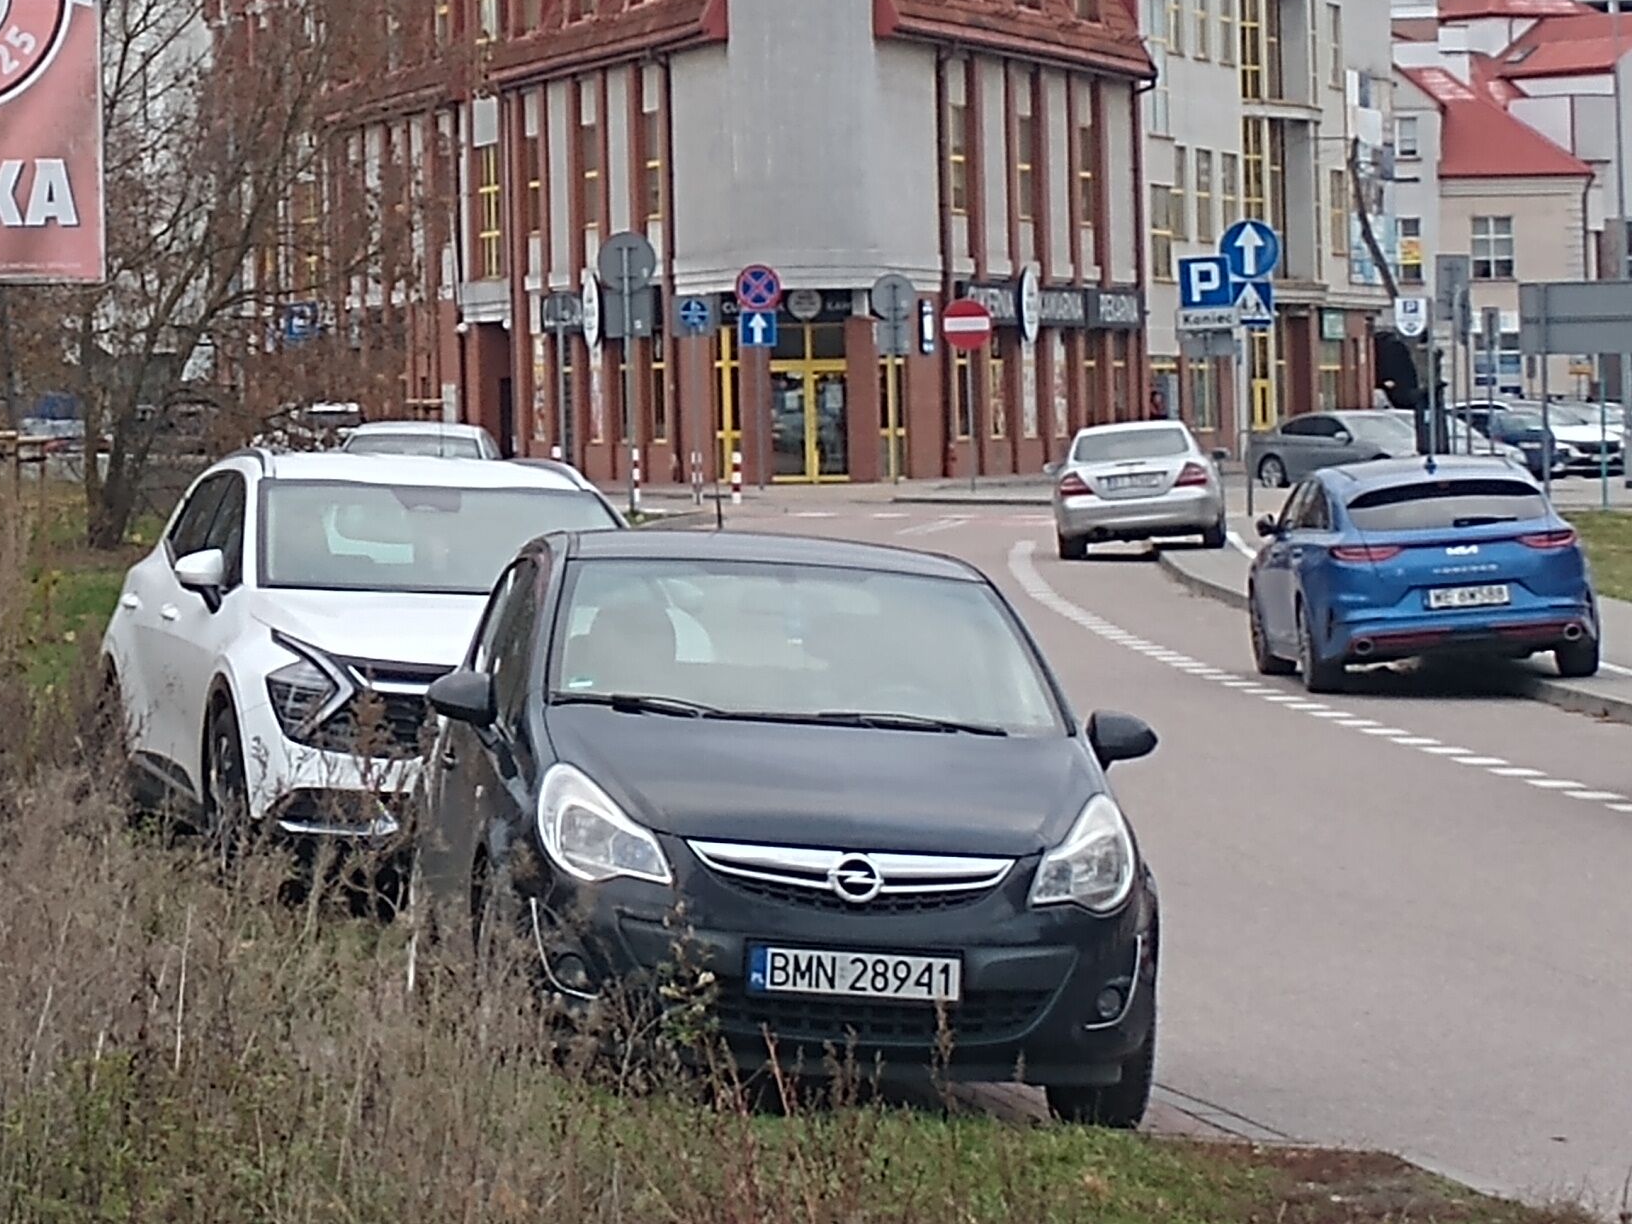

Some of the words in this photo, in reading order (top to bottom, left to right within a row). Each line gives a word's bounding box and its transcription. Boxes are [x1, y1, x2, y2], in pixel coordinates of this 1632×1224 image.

[1190, 262, 1220, 302] P
[1183, 313, 1233, 325] Koniec
[769, 952, 836, 989] BMN
[849, 957, 951, 996] 28941
